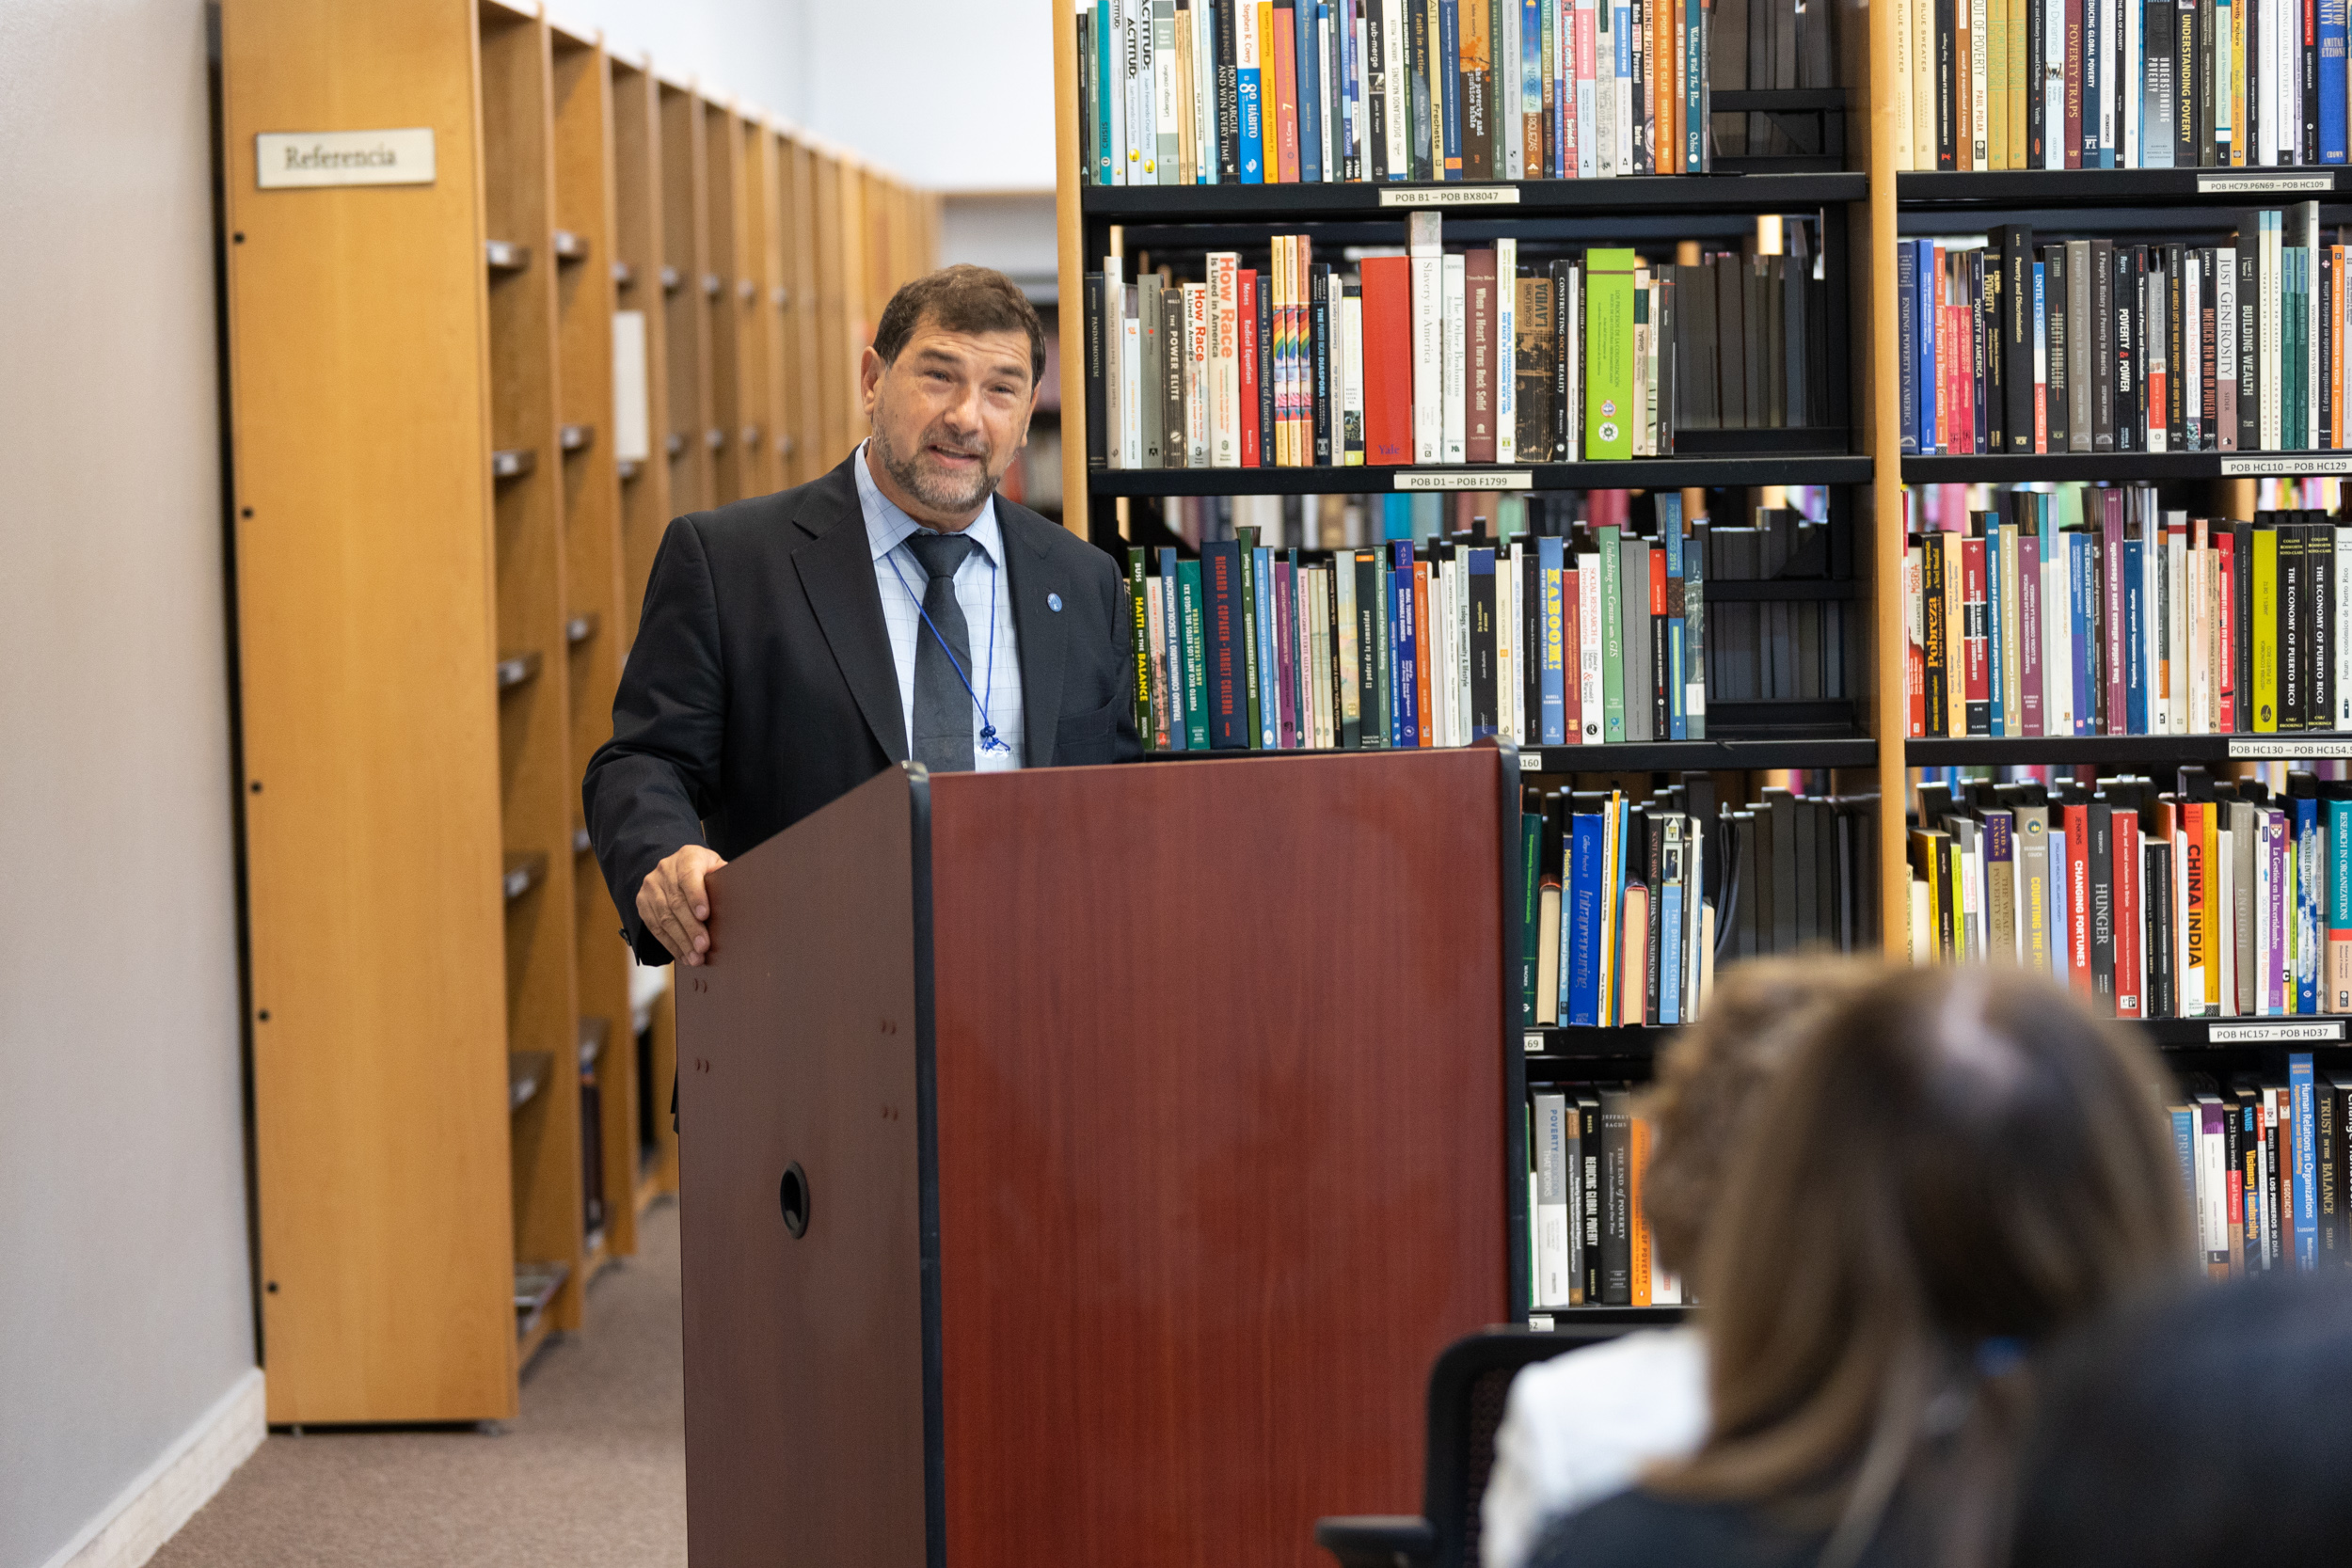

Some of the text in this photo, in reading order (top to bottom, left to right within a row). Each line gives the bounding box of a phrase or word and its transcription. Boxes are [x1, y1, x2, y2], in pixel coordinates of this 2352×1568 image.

[1243, 4, 1251, 32] Stephen
[1370, 22, 1379, 68] sub-merge
[1632, 24, 1641, 51] POVERTY
[1690, 26, 1698, 55] Walking
[2069, 24, 2078, 118] POVERTY TRAPS
[2149, 58, 2157, 92] POVERTY
[2182, 14, 2191, 142] UNDERSTANDING POVERTY
[1229, 91, 1236, 103] TO
[2160, 57, 2169, 122] UNDERSTANDING
[1248, 104, 1258, 138] HÁBITO
[1566, 119, 1575, 148] Swindoll
[284, 143, 397, 168] Referencia
[1689, 132, 1698, 152] Orbis
[1395, 193, 1415, 202] POB
[1418, 193, 1430, 201] B1
[1440, 192, 1460, 201] POB
[1462, 191, 1499, 201] BX8047
[2211, 182, 2227, 190] POB
[2229, 182, 2274, 190] HC79.P6N69
[2299, 181, 2324, 189] HC109
[1211, 258, 1218, 266] Is
[1212, 300, 1219, 310] in
[1220, 257, 1234, 358] How Race
[1476, 288, 1486, 309] When
[1476, 320, 1486, 341] Heart
[2119, 309, 2129, 349] POVERTY
[2218, 259, 2233, 376] JUST GENEROSITY
[1244, 320, 1252, 346] Radical
[1476, 345, 1486, 367] Turns
[2242, 305, 2253, 396] BUILDING WEALTH
[1170, 374, 1179, 400] ELITE
[1476, 370, 1486, 388] Rock
[2120, 360, 2130, 391] POWER
[1476, 391, 1486, 410] Solid
[1410, 477, 1430, 486] POB
[1433, 477, 1446, 486] D1
[1456, 477, 1476, 486] POB
[1479, 477, 1507, 486] F1799
[2231, 463, 2250, 472] POB
[2253, 463, 2283, 472] HC110
[2294, 462, 2314, 471] POB
[2316, 462, 2346, 471] HC129
[1216, 556, 1228, 591] RICHARD
[1135, 597, 1145, 627] HAITI
[1217, 605, 1230, 641] COPAKEN
[1548, 568, 1561, 670] KABOOM!
[1926, 597, 1937, 667] Pobreza
[2316, 631, 2324, 642] OF
[1137, 653, 1148, 701] BALANCE
[1219, 648, 1232, 676] TARGET
[1220, 679, 1232, 715] CULEBRA
[2231, 746, 2250, 754] POB
[2253, 746, 2283, 754] HC130
[2294, 746, 2314, 754] POB
[1563, 849, 1571, 878] Mission,
[2339, 812, 2348, 920] RESEARCH IN ORGANIZATIONS
[2030, 878, 2042, 950] COUNTING THE
[2074, 861, 2085, 967] CHANGING FORTUNES
[2095, 883, 2108, 944] HUNGER
[2187, 844, 2201, 969] CHINA INDIA
[2217, 1031, 2237, 1039] POB
[2239, 1030, 2269, 1038] HC157
[2280, 1029, 2300, 1038] POB
[2302, 1028, 2328, 1037] HD37
[2302, 1083, 2312, 1112] Human
[2244, 1107, 2253, 1132] NANUS
[2321, 1099, 2332, 1135] TRUST
[2303, 1114, 2312, 1151] Relations
[1585, 1157, 1597, 1245] REDUCING GLOBAL POVERTY
[2245, 1150, 2258, 1240] Visionary Leadership
[2303, 1163, 2313, 1218] Organizations
[2322, 1163, 2333, 1214] BALANCE
